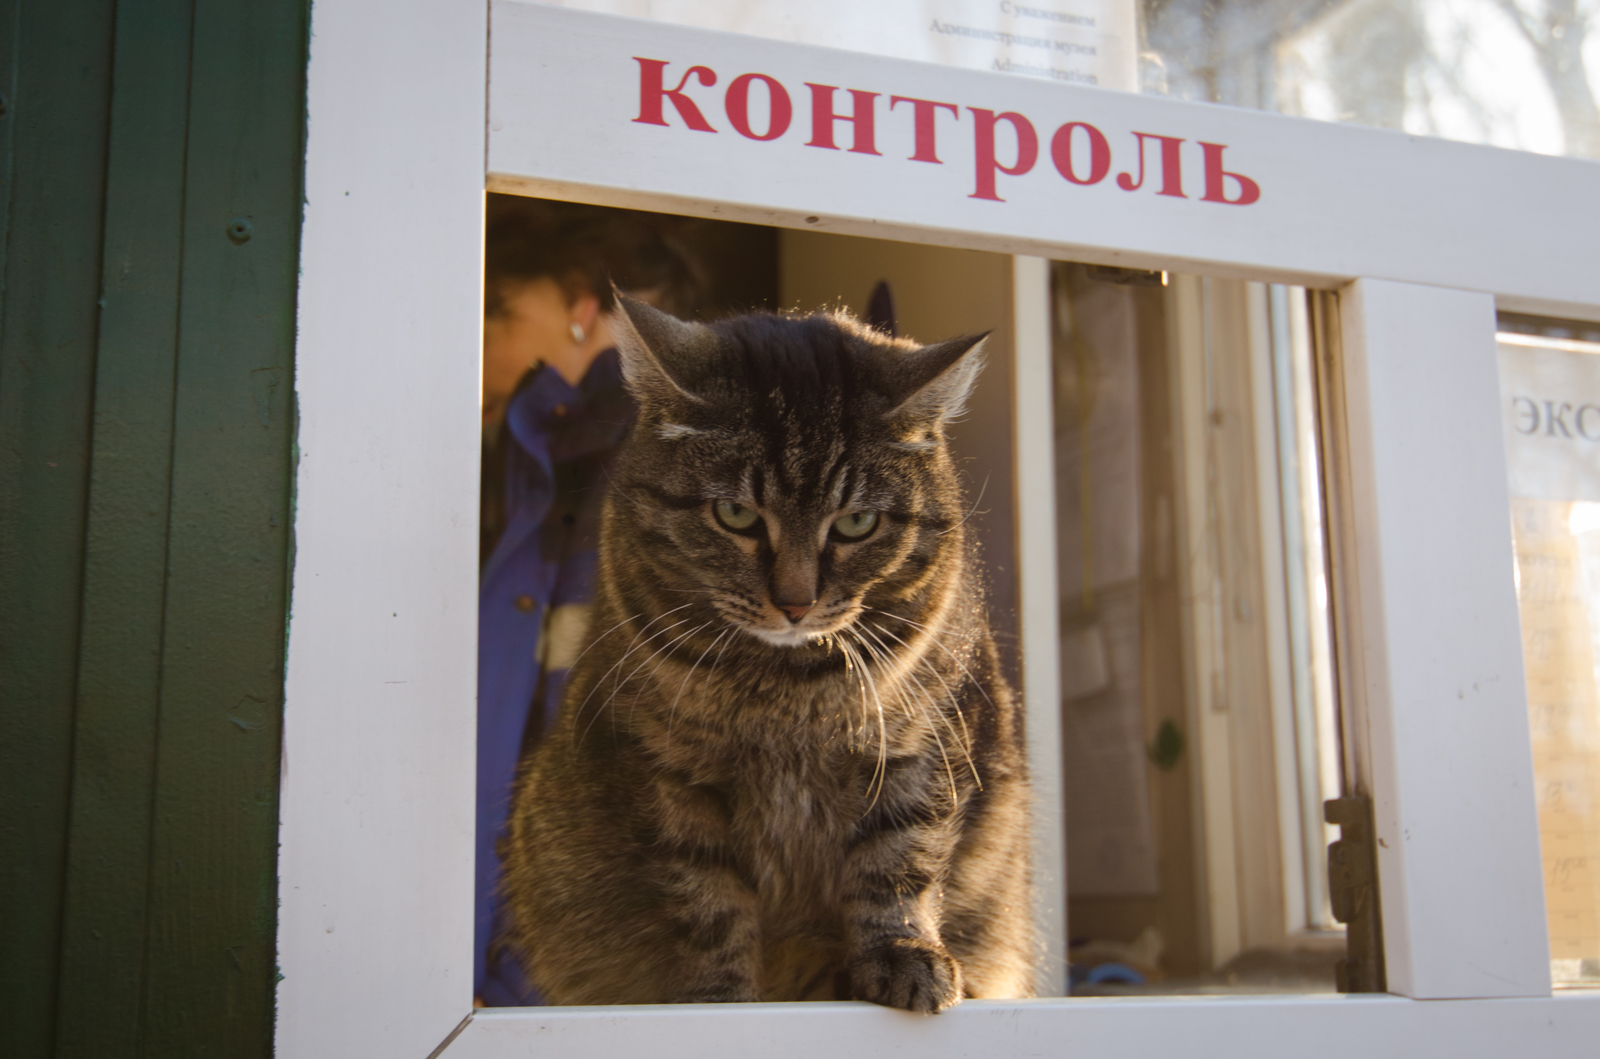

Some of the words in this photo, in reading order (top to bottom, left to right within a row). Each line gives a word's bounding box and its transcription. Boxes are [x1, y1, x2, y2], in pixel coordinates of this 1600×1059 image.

[930, 18, 1051, 49] Администрация
[1054, 40, 1097, 56] музея
[992, 57, 1098, 85] Administration
[631, 55, 1262, 207] контроль
